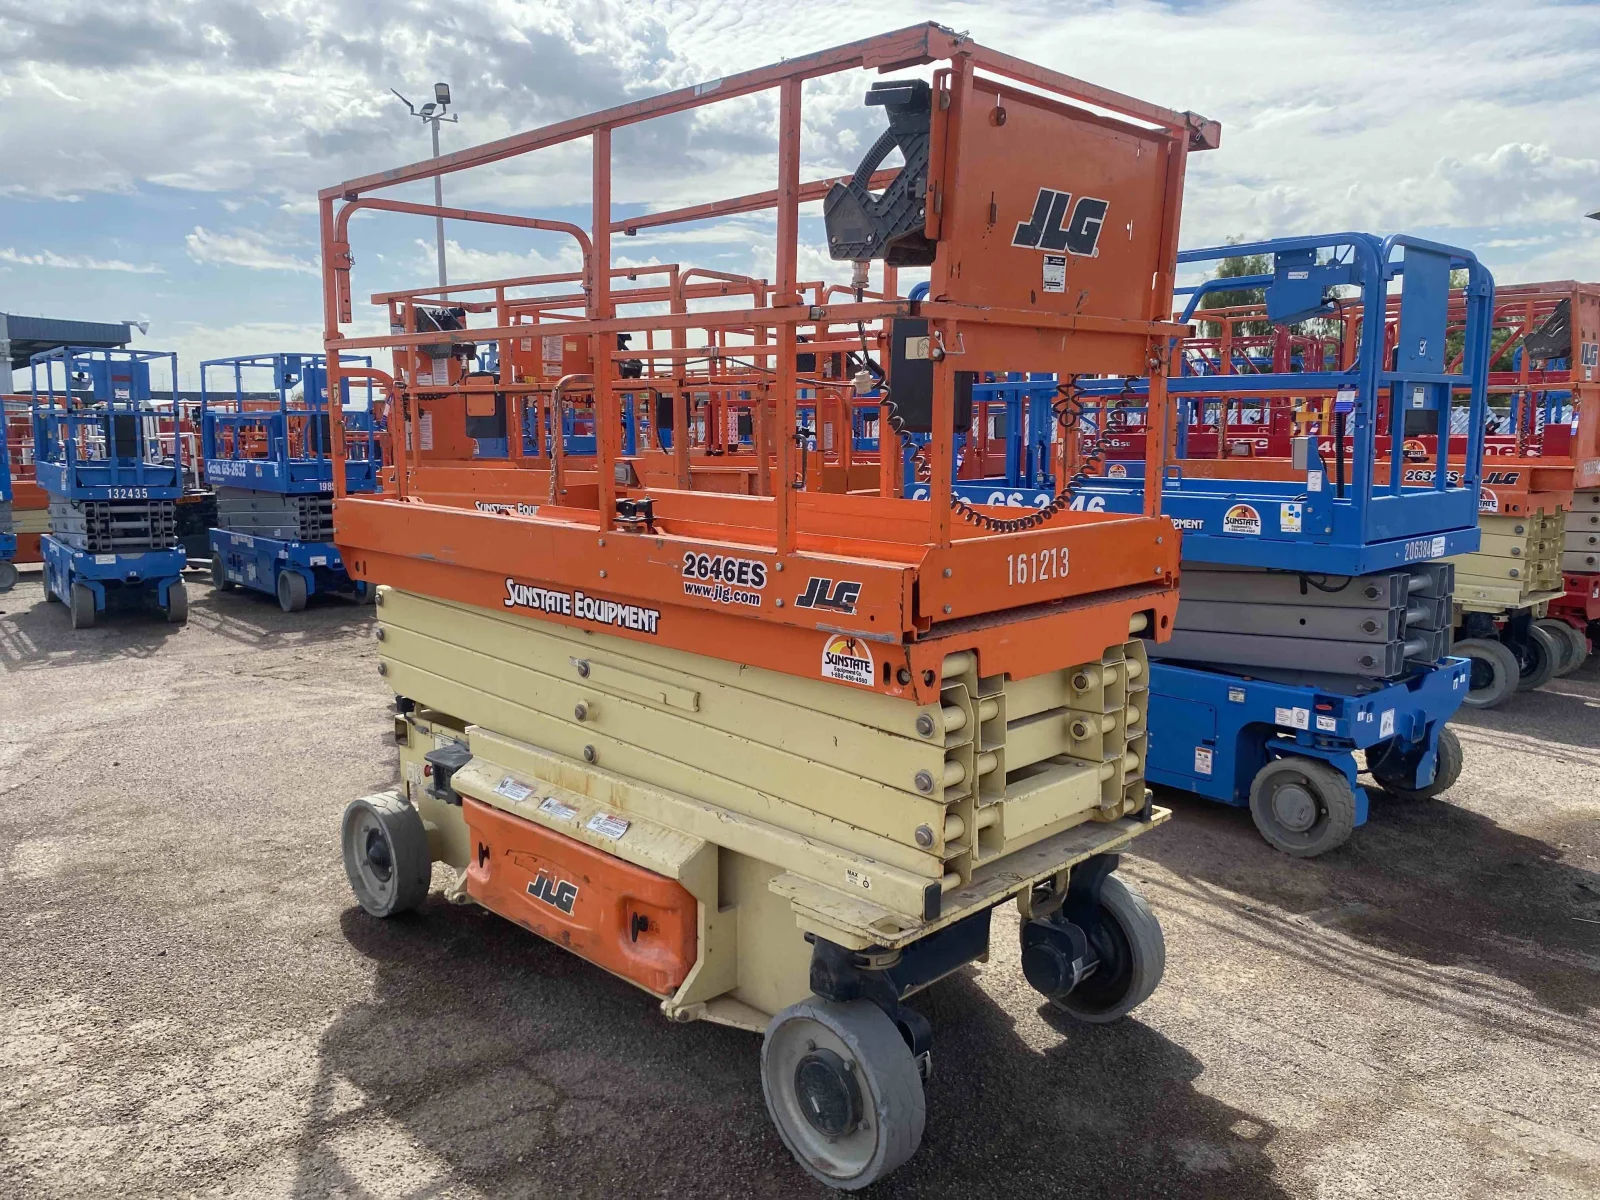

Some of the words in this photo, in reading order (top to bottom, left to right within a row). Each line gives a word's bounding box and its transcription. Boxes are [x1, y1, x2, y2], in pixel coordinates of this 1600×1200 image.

[1011, 187, 1110, 258] JLG
[1481, 472, 1520, 486] JLG
[107, 488, 148, 499] 132435
[1225, 516, 1260, 527] SUNSTATE
[1405, 540, 1431, 561] 206384
[683, 551, 768, 589] 2646ES
[1007, 547, 1069, 586] 161213
[504, 577, 571, 615] SUNSTATE
[574, 590, 661, 634] EQUIPMENT
[684, 582, 761, 607] www.jlg.com
[795, 577, 863, 615] JLG
[825, 651, 873, 674] SUNSTATE
[834, 666, 856, 676] Equipment
[526, 868, 579, 917] JLG
